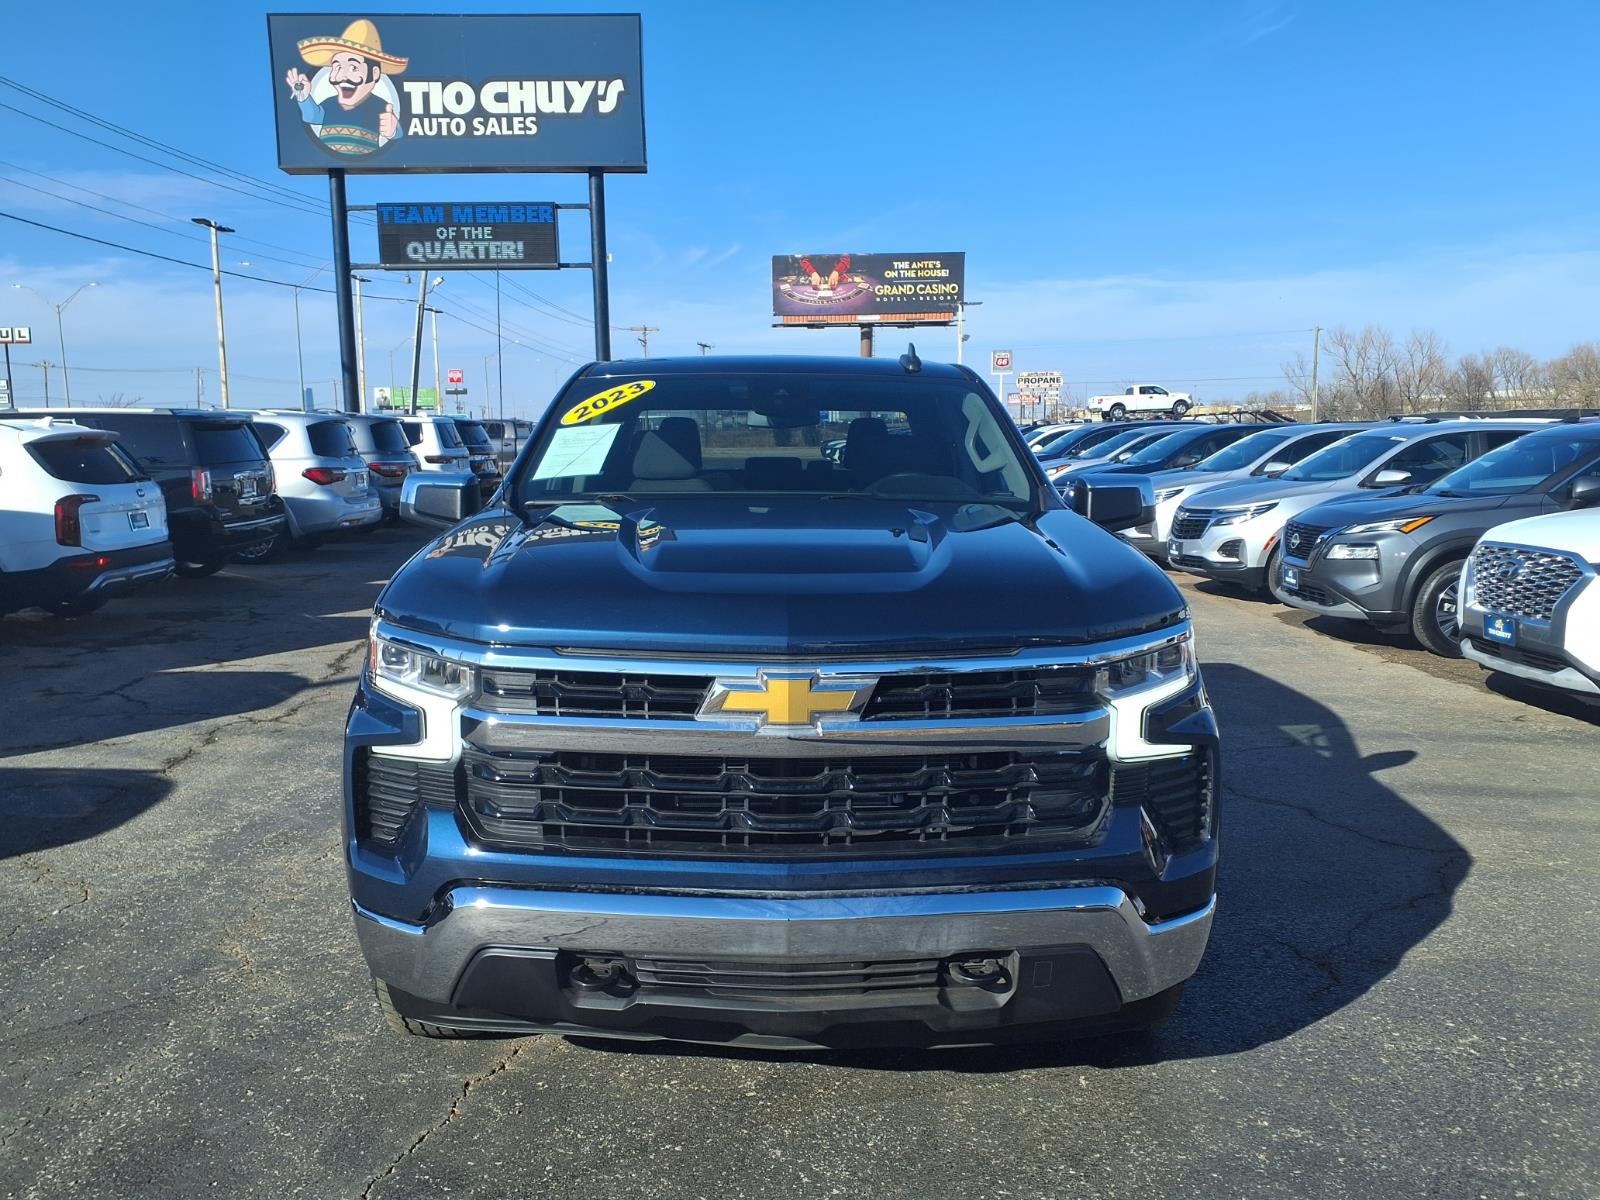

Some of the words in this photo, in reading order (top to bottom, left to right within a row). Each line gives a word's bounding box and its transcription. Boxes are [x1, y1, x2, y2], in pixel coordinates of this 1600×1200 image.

[403, 81, 476, 115] TIO
[480, 79, 625, 114] CHUY'S
[408, 117, 467, 136] AUTO
[472, 116, 538, 136] SALES
[378, 206, 445, 224] TEAM
[452, 205, 554, 224] MEMBER
[436, 227, 457, 240] OF
[461, 226, 493, 239] THE
[406, 240, 525, 262] QUARTER!
[893, 261, 910, 269] THE
[911, 260, 942, 269] ANTE'S
[884, 270, 898, 278] ON
[898, 269, 917, 278] THE
[917, 269, 950, 277] HOUSE!
[874, 284, 915, 295] GRAND
[916, 283, 959, 294] CASINO
[1017, 376, 1062, 384] PROPANE
[573, 382, 646, 420] 2023
